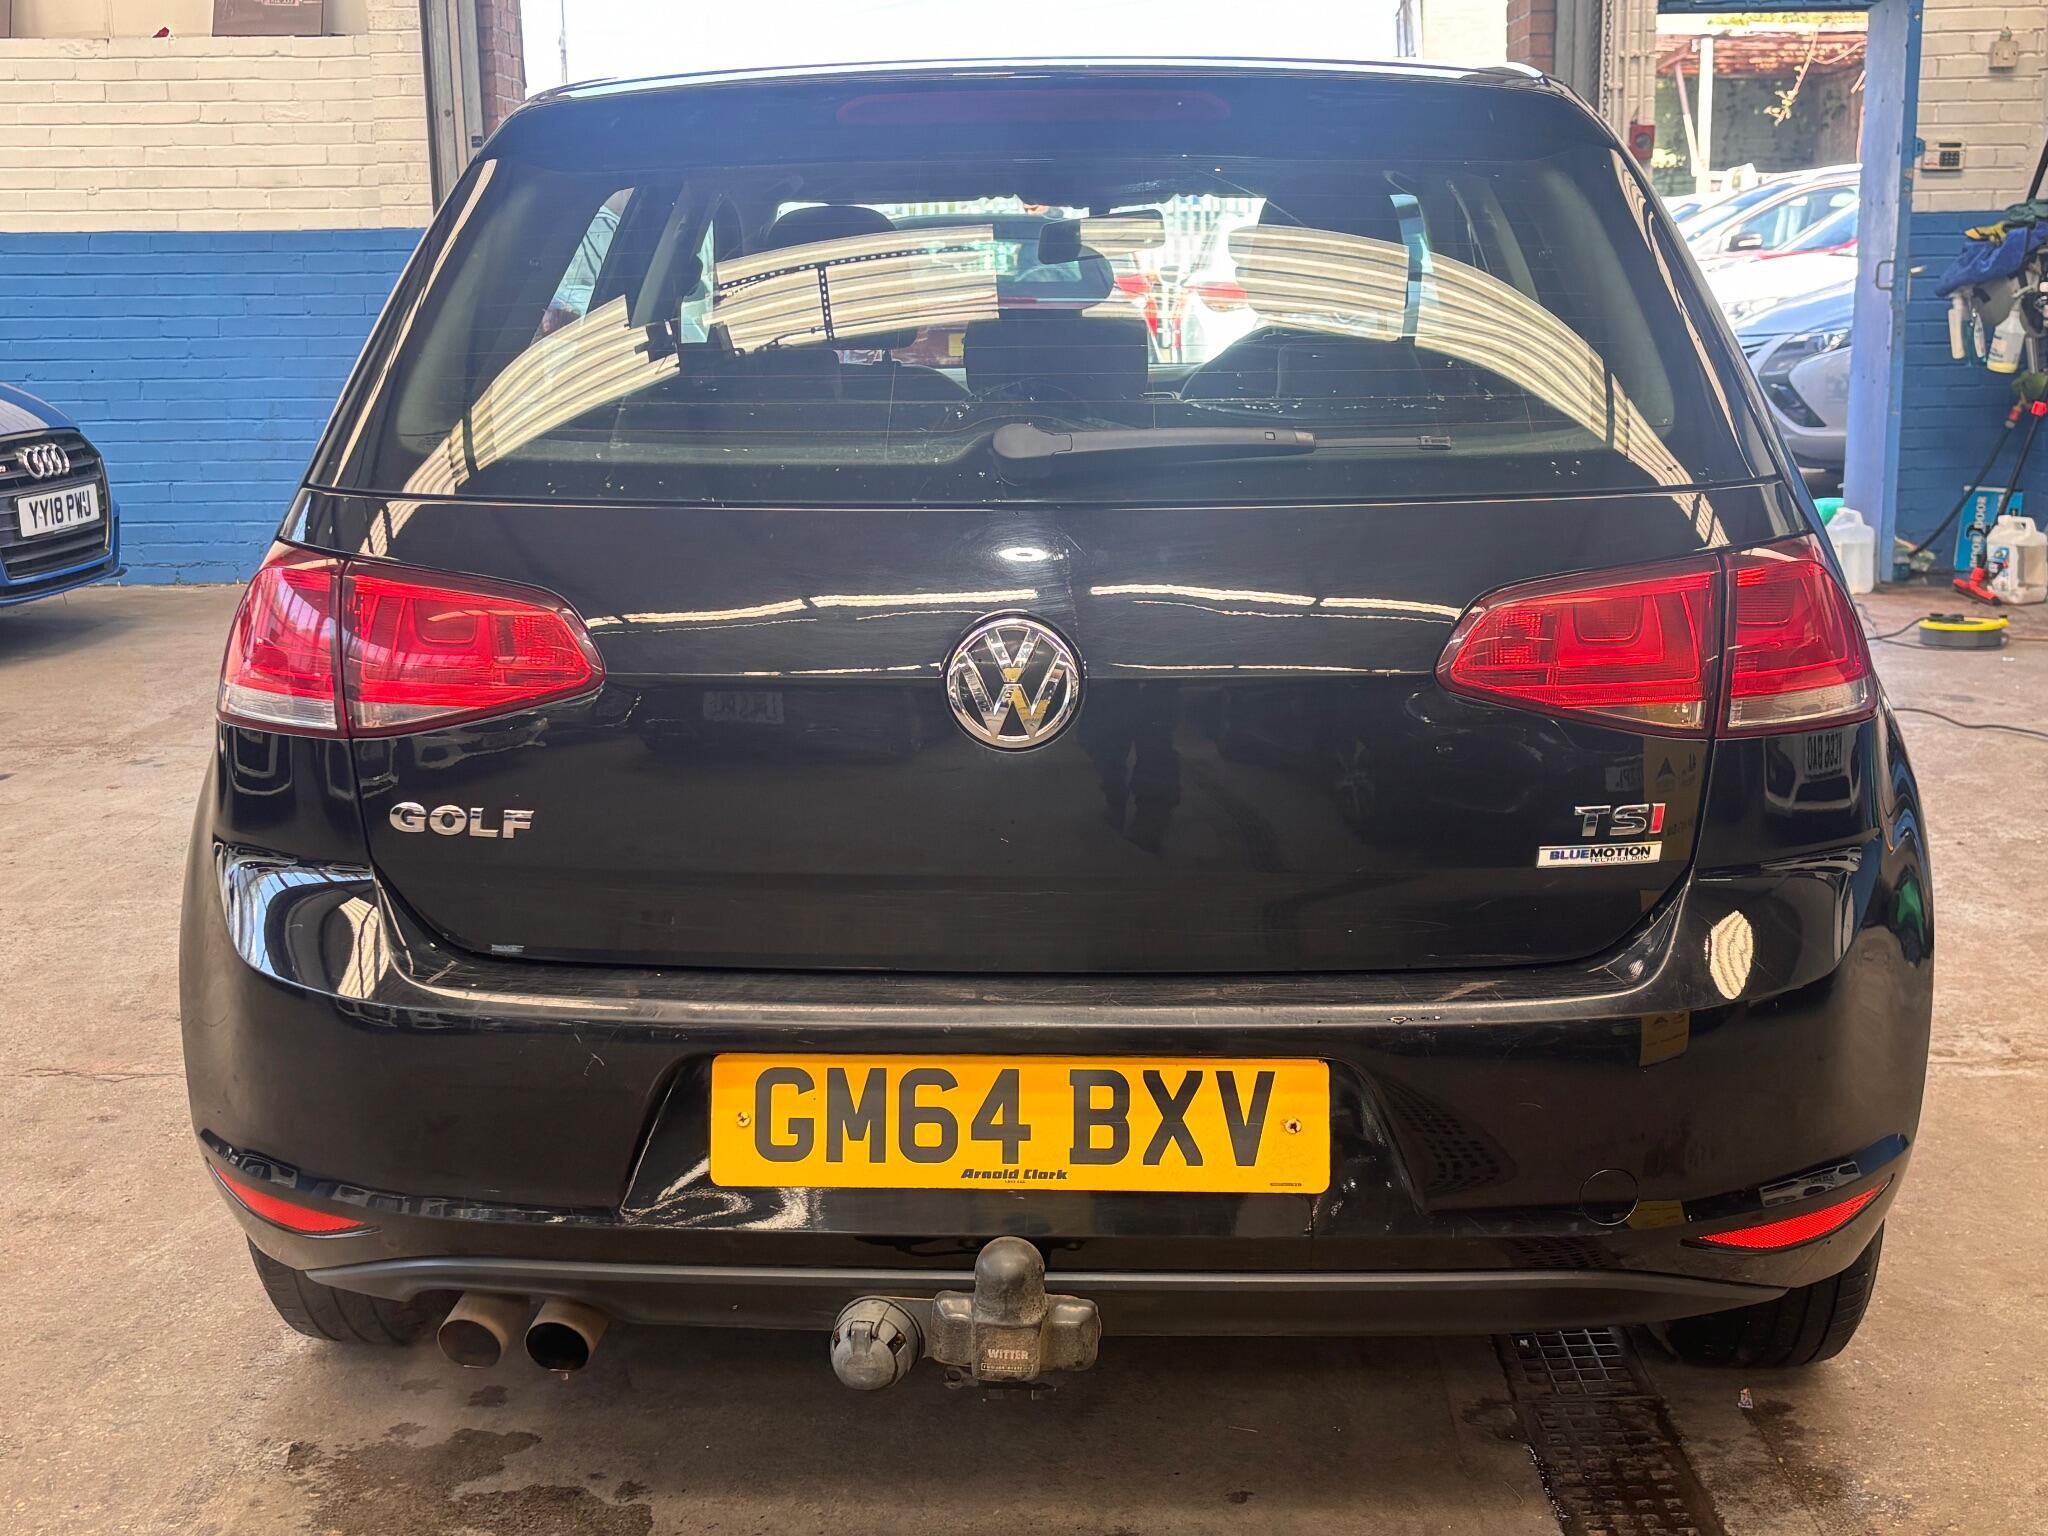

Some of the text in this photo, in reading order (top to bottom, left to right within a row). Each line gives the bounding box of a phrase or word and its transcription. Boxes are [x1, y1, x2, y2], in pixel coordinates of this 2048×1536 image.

[29, 496, 64, 529] YY18
[389, 801, 536, 839] GOLF
[1574, 802, 1666, 837] TSI
[1549, 846, 1651, 860] BLUEMOTION
[754, 1066, 1276, 1167] GM64 BXV
[961, 1168, 1068, 1180] Arnold Clark
[987, 1348, 1029, 1360] WITTER
